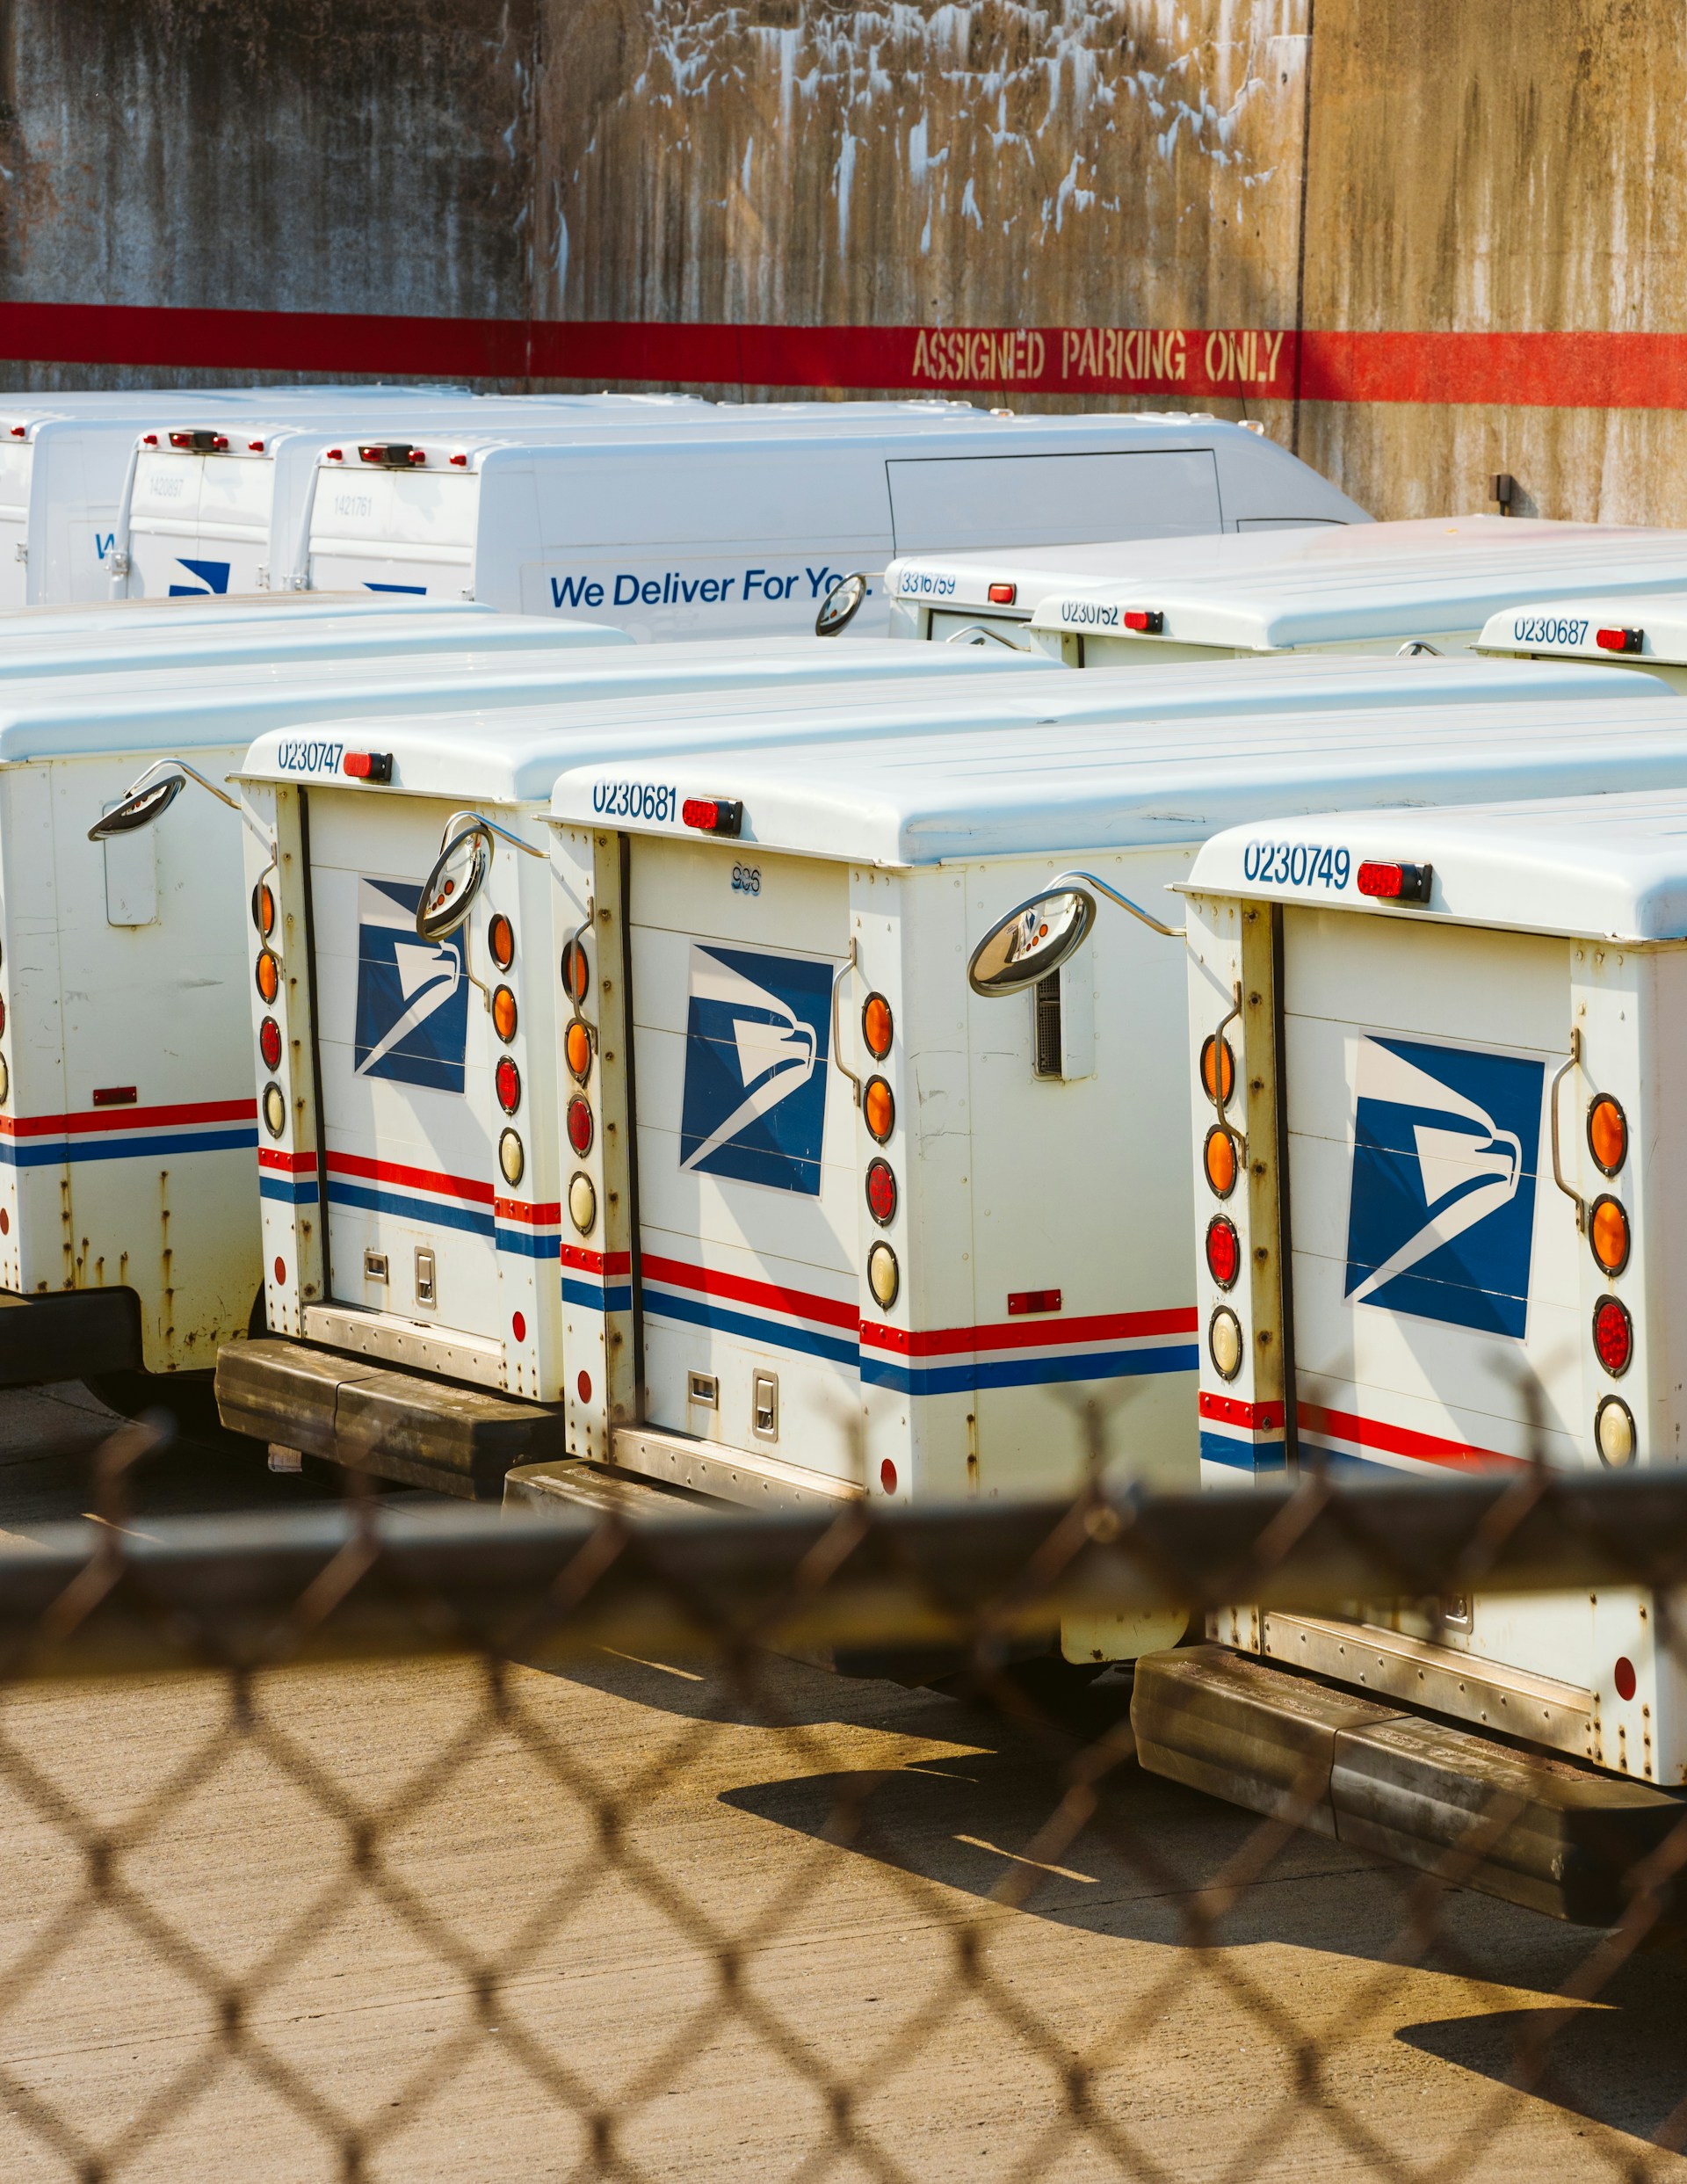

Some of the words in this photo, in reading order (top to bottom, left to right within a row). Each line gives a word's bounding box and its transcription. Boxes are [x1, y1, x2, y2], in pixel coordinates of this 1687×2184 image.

[912, 329, 1046, 381] ASSIGNED
[1061, 328, 1186, 381] PARKING
[1205, 330, 1285, 382] ONLY
[334, 493, 373, 517] 1421761
[550, 576, 605, 608] We
[613, 572, 735, 606] Deliver
[742, 569, 800, 601] For
[805, 567, 872, 599] Yo.
[901, 571, 957, 595] 3316759
[1061, 600, 1119, 626] 0230752
[1514, 617, 1589, 646] 0230687
[278, 737, 344, 774] 0230747
[593, 777, 677, 823] 0230681
[1244, 838, 1350, 890] 0230749
